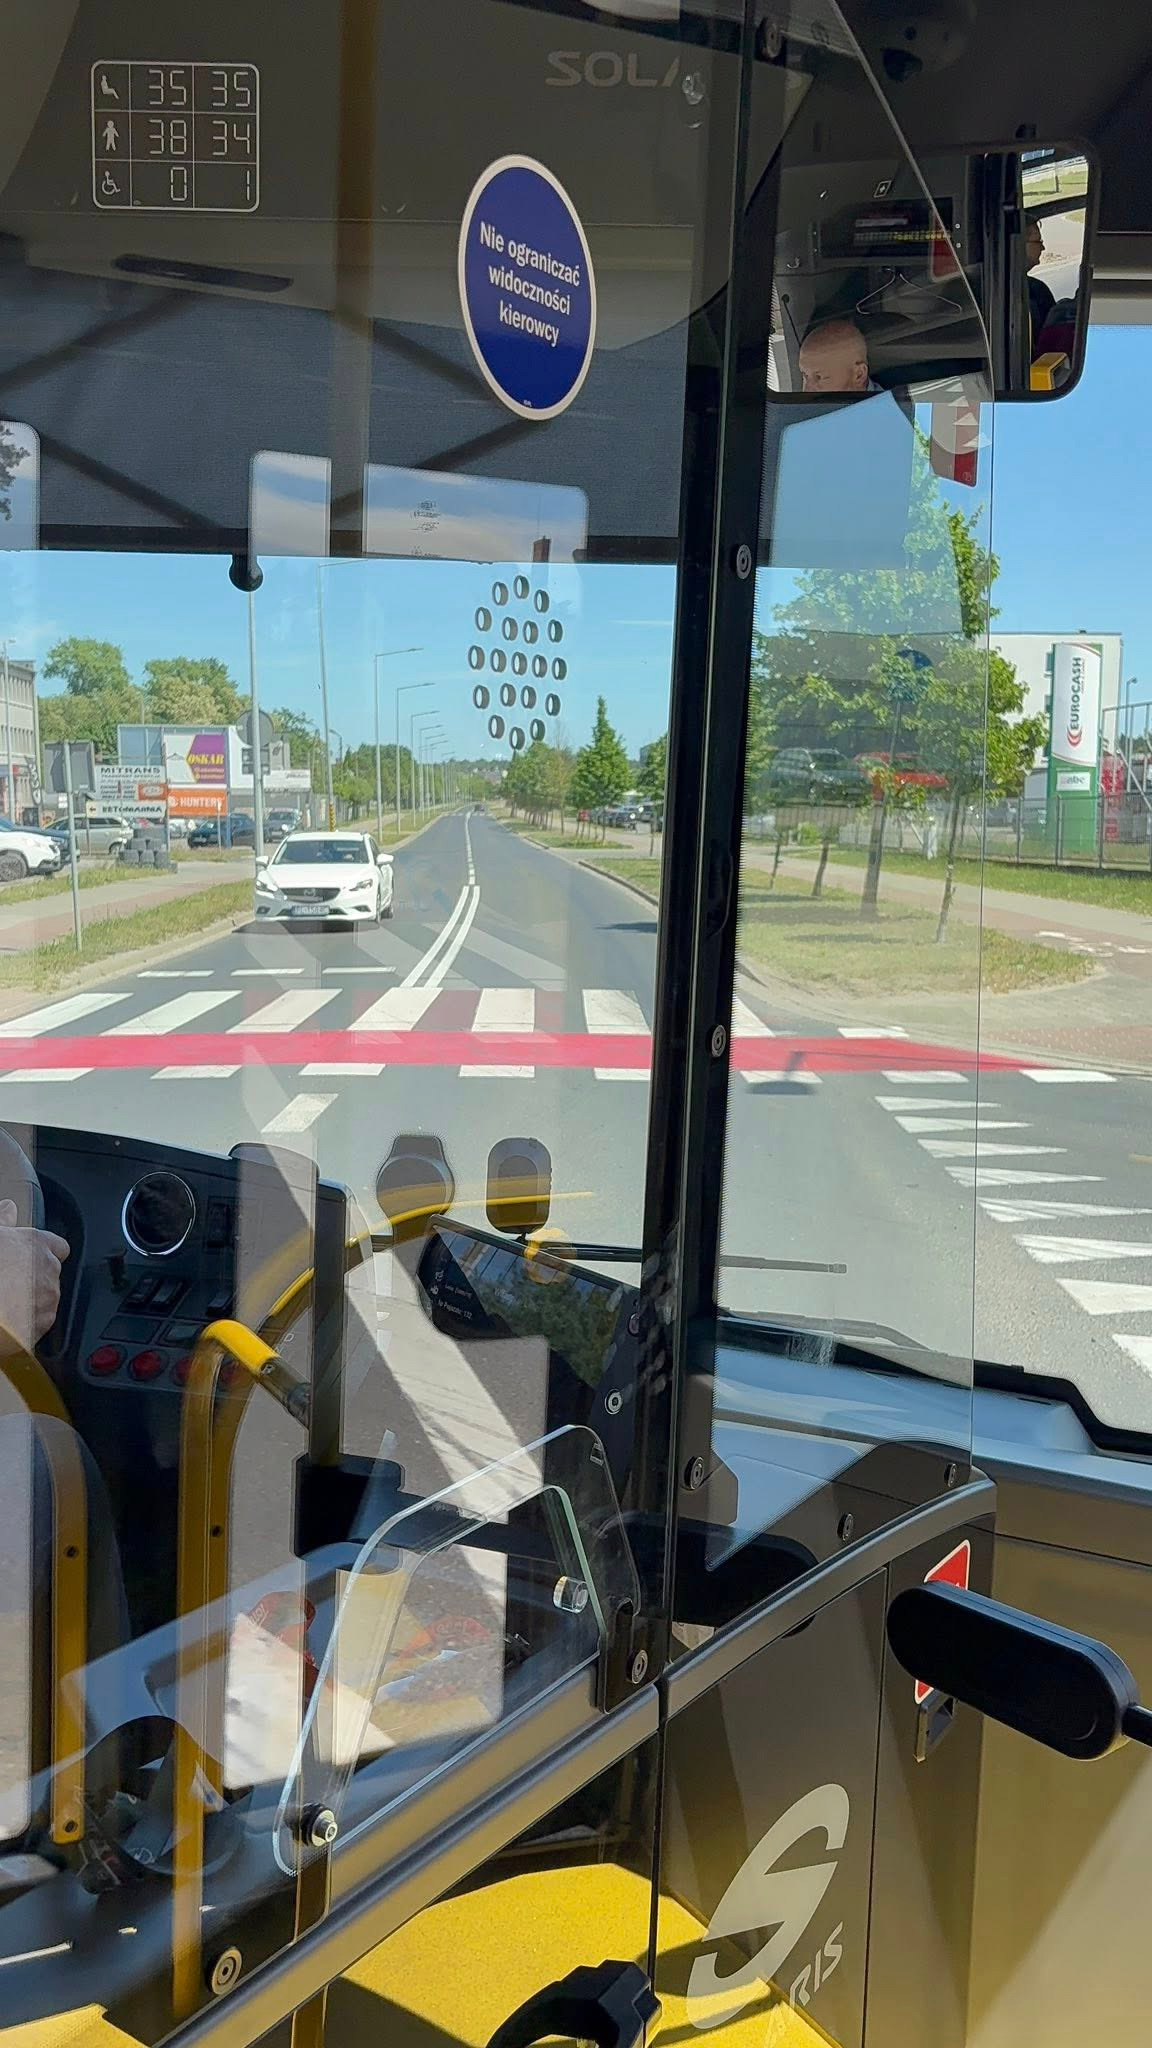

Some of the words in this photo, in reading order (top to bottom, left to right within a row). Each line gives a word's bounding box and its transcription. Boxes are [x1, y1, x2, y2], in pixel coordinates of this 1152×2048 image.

[149, 69, 187, 106] 35
[212, 71, 251, 107] 35
[149, 119, 187, 155] 38
[212, 120, 250, 156] 34
[170, 166, 187, 201] 0
[246, 170, 250, 201] 1
[479, 221, 504, 253] Nie
[508, 241, 580, 287] ograniczać
[488, 265, 571, 316] widoczności
[499, 300, 560, 348] kierowcy
[1070, 656, 1082, 731] EUROCASH
[187, 753, 225, 765] OSKAR
